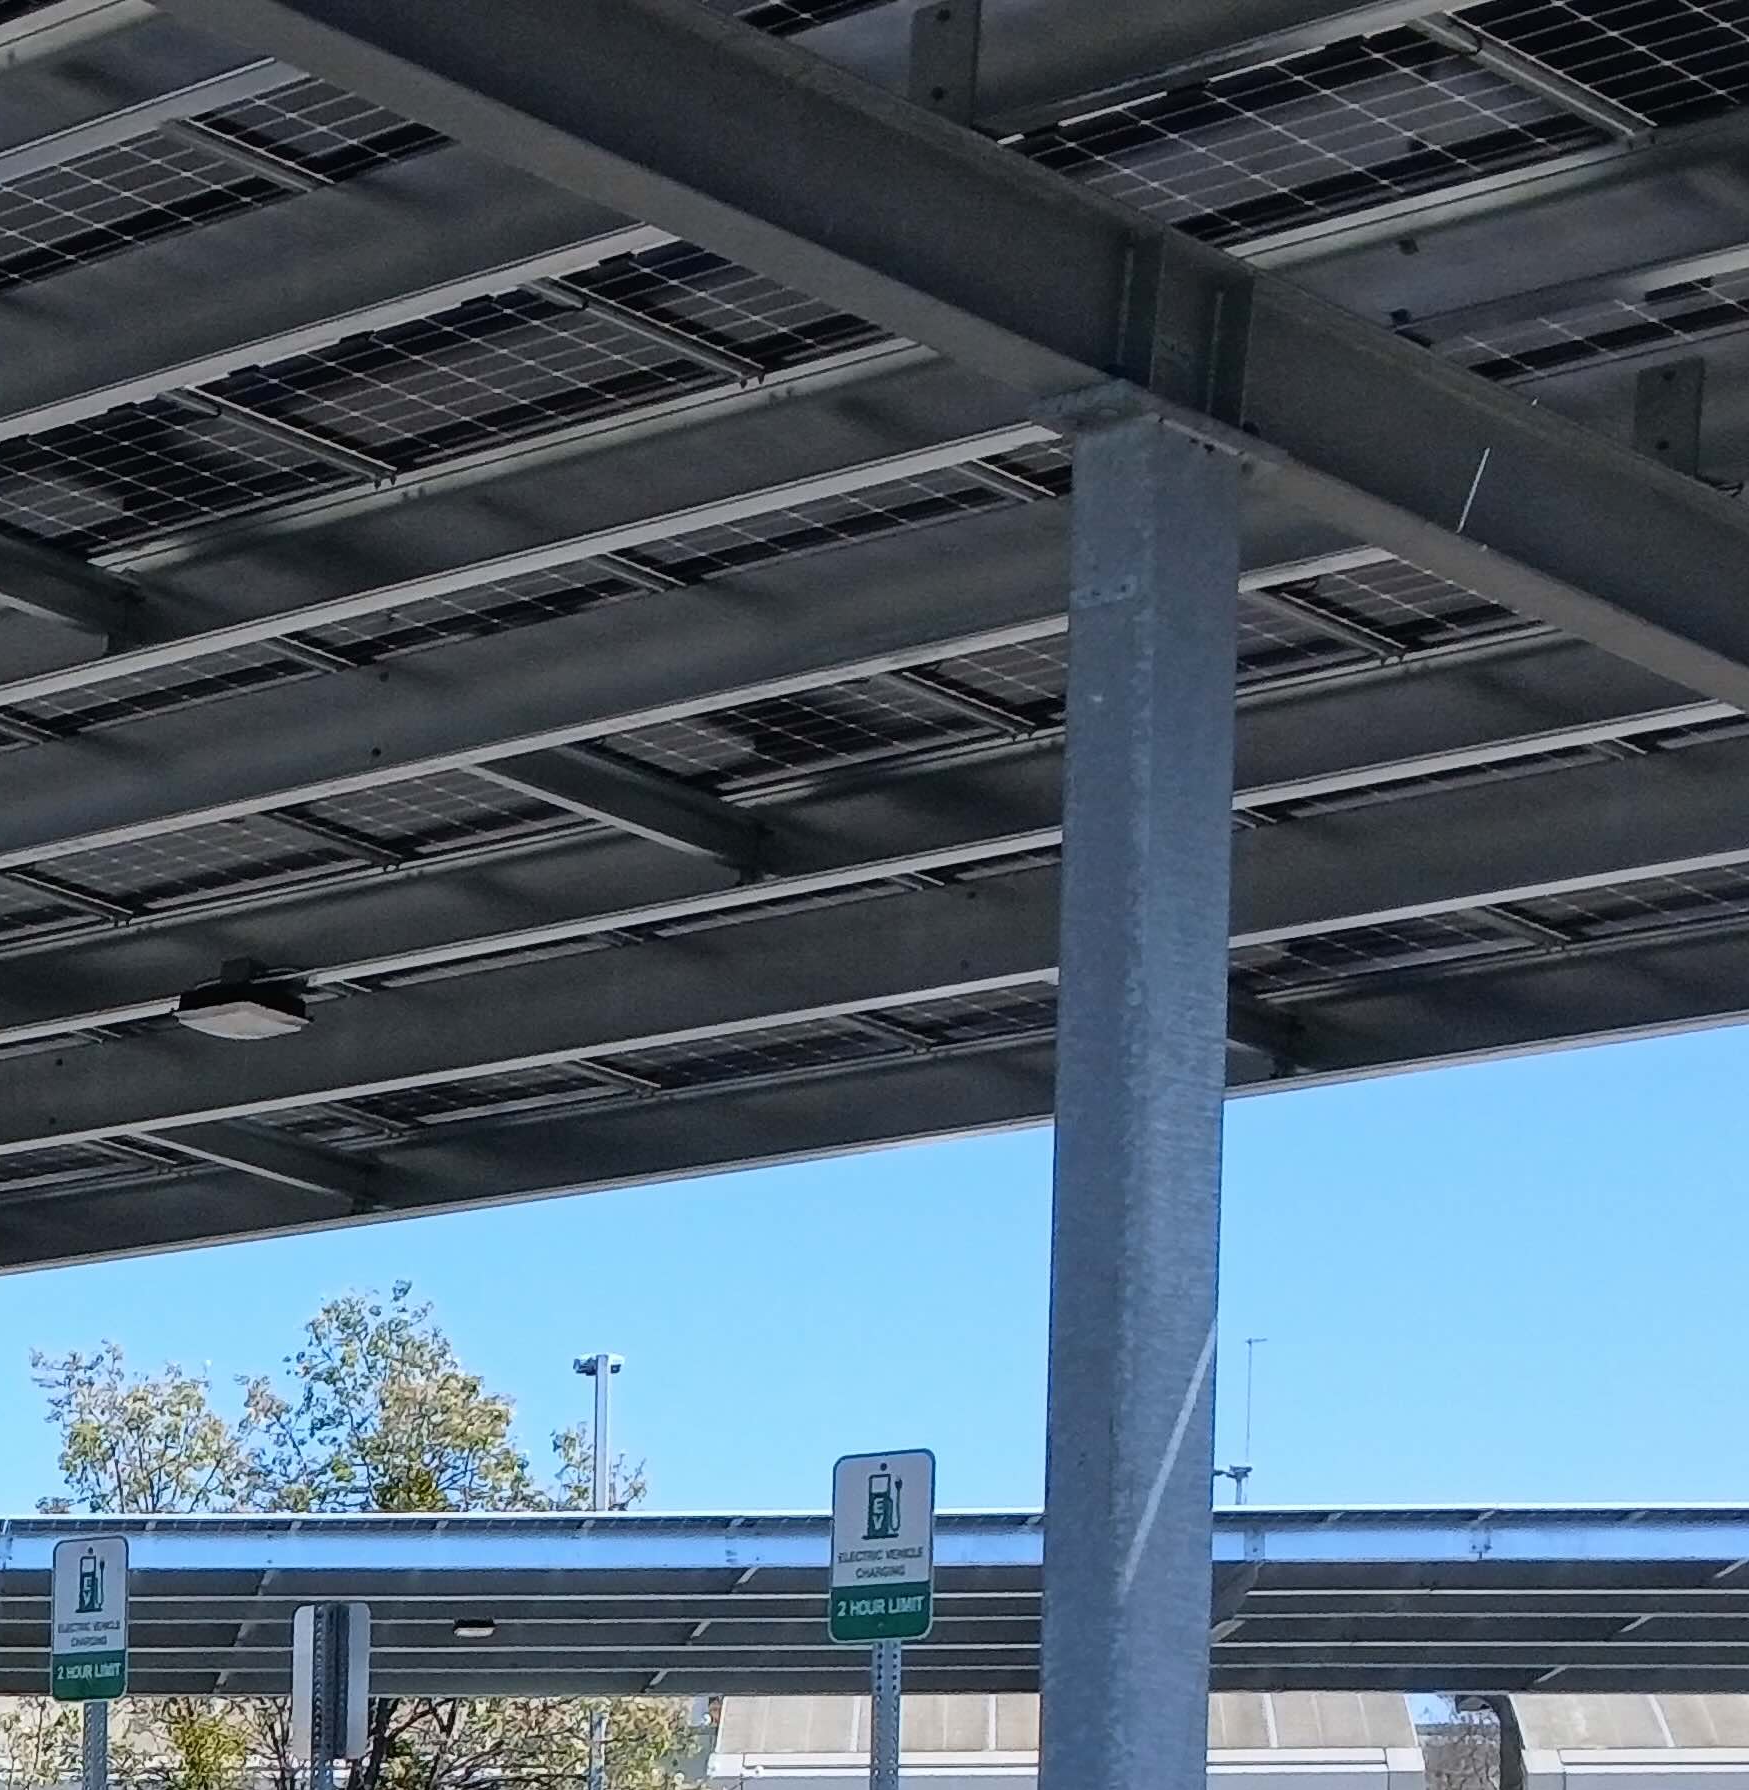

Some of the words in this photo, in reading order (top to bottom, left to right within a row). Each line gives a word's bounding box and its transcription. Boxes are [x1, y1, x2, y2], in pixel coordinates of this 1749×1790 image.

[838, 1550, 883, 1564] ELECTRIC
[885, 1547, 924, 1560] VEHICLE
[855, 1566, 906, 1580] CHARGING
[837, 1601, 848, 1617] 2
[852, 1599, 886, 1616] HOUR
[888, 1596, 926, 1614] LIMIT
[57, 1666, 64, 1680] 2
[67, 1665, 93, 1679] HOUR
[94, 1663, 121, 1678] LIMIT
